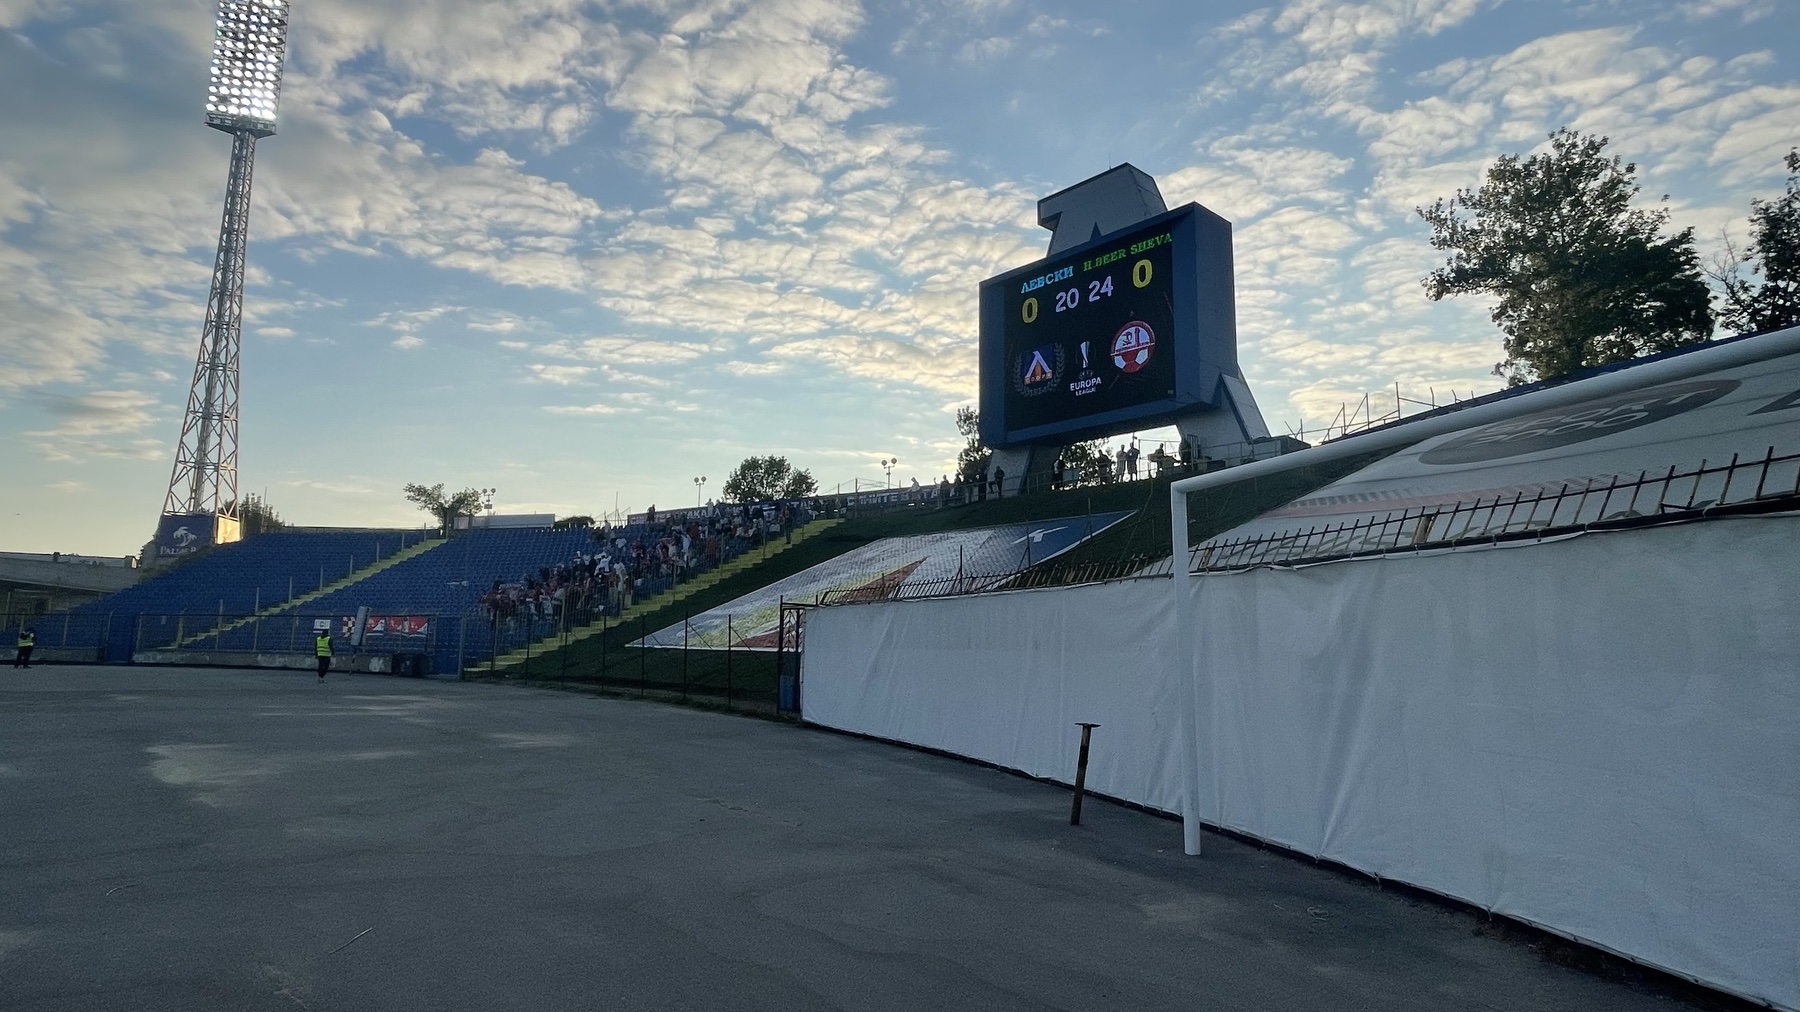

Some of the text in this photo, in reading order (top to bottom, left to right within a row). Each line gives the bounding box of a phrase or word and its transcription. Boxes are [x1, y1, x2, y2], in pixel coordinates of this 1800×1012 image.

[1083, 233, 1172, 271] H.BEER SHEVA
[1133, 259, 1153, 288] 0
[1055, 276, 1114, 312] 20 24
[1022, 298, 1038, 323] 0
[1070, 377, 1102, 391] EUROPA
